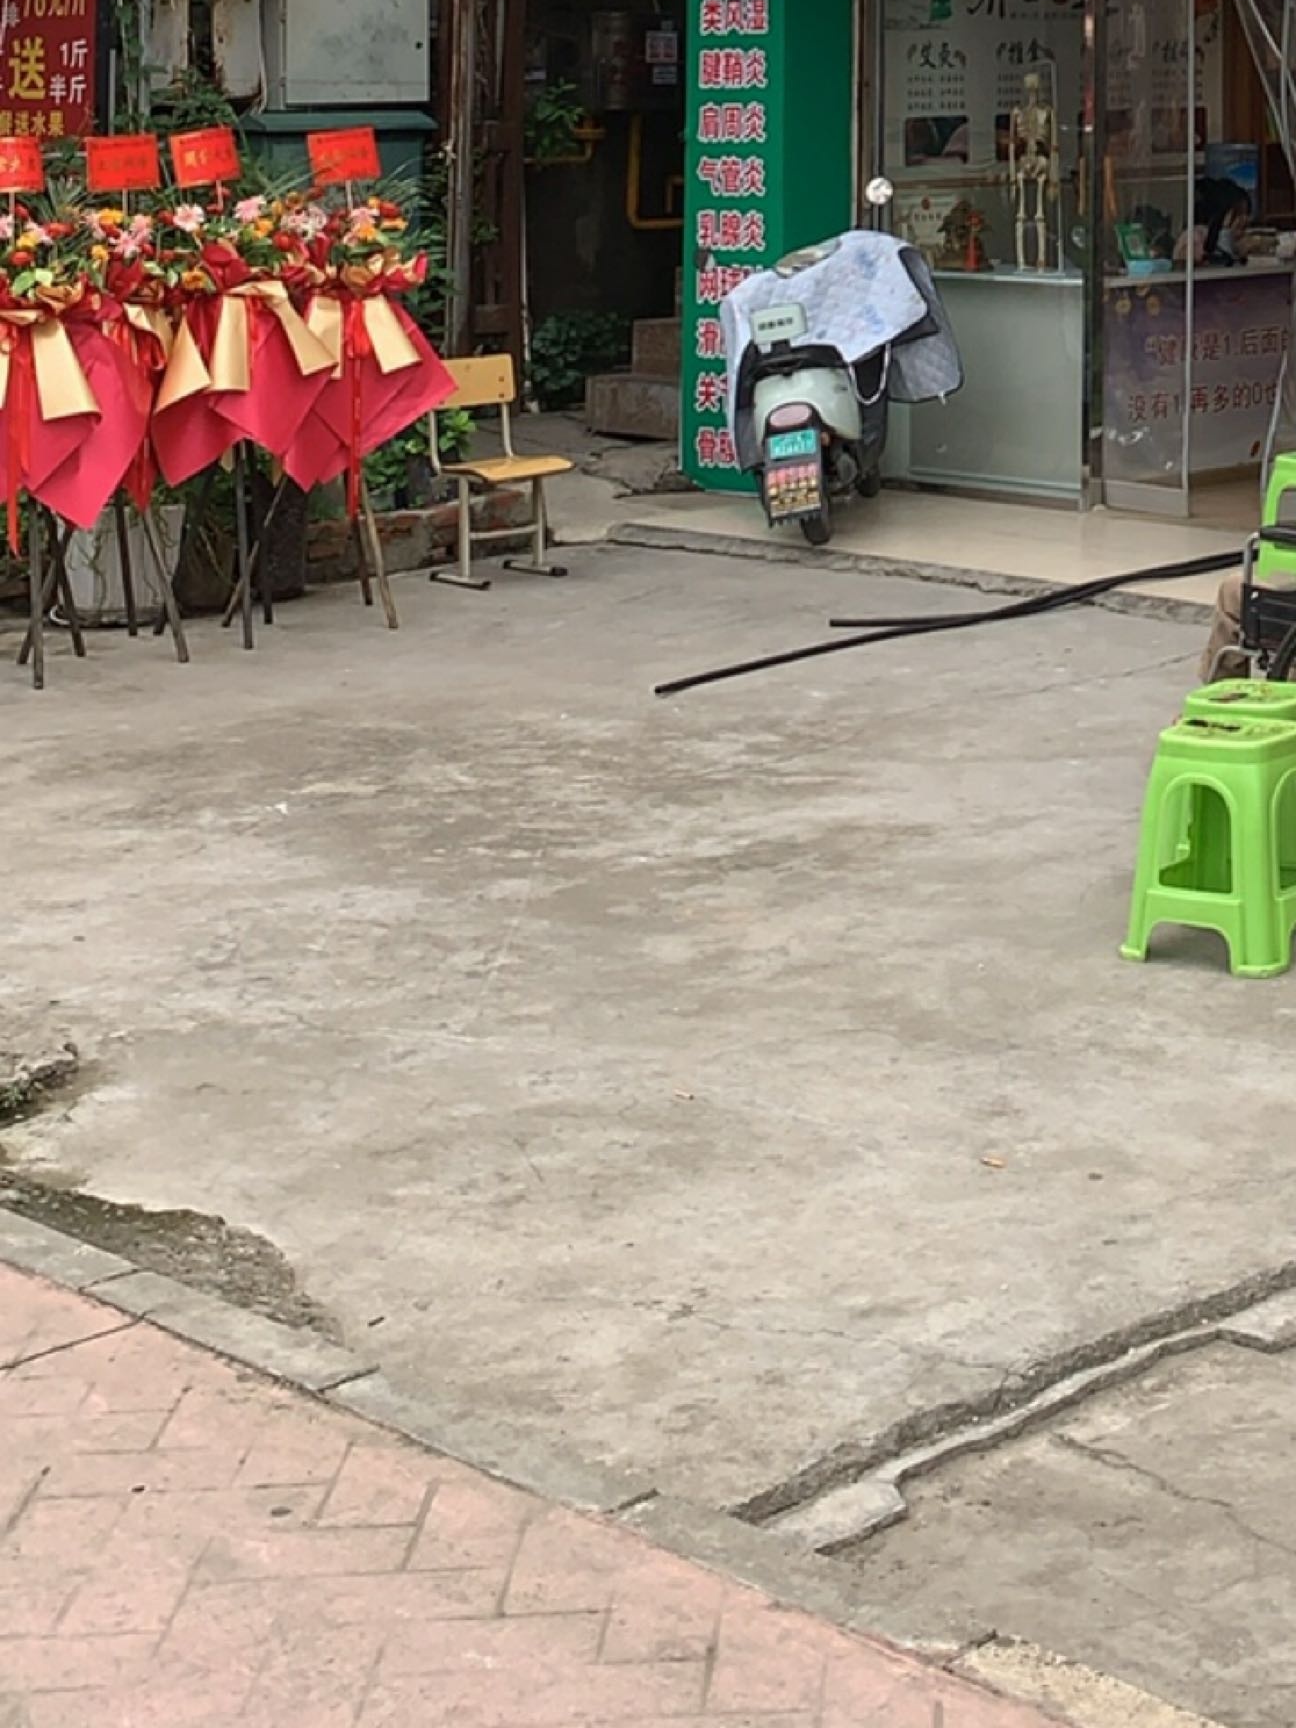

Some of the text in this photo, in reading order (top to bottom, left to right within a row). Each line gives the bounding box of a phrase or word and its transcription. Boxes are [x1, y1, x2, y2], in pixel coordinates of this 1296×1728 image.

[9, 36, 46, 100] 送
[59, 38, 88, 68] 1斤
[49, 73, 87, 105] 半斤
[697, 102, 766, 143] 肩周炎
[697, 156, 766, 197] 气管炎
[696, 209, 765, 251] 乳腺炎
